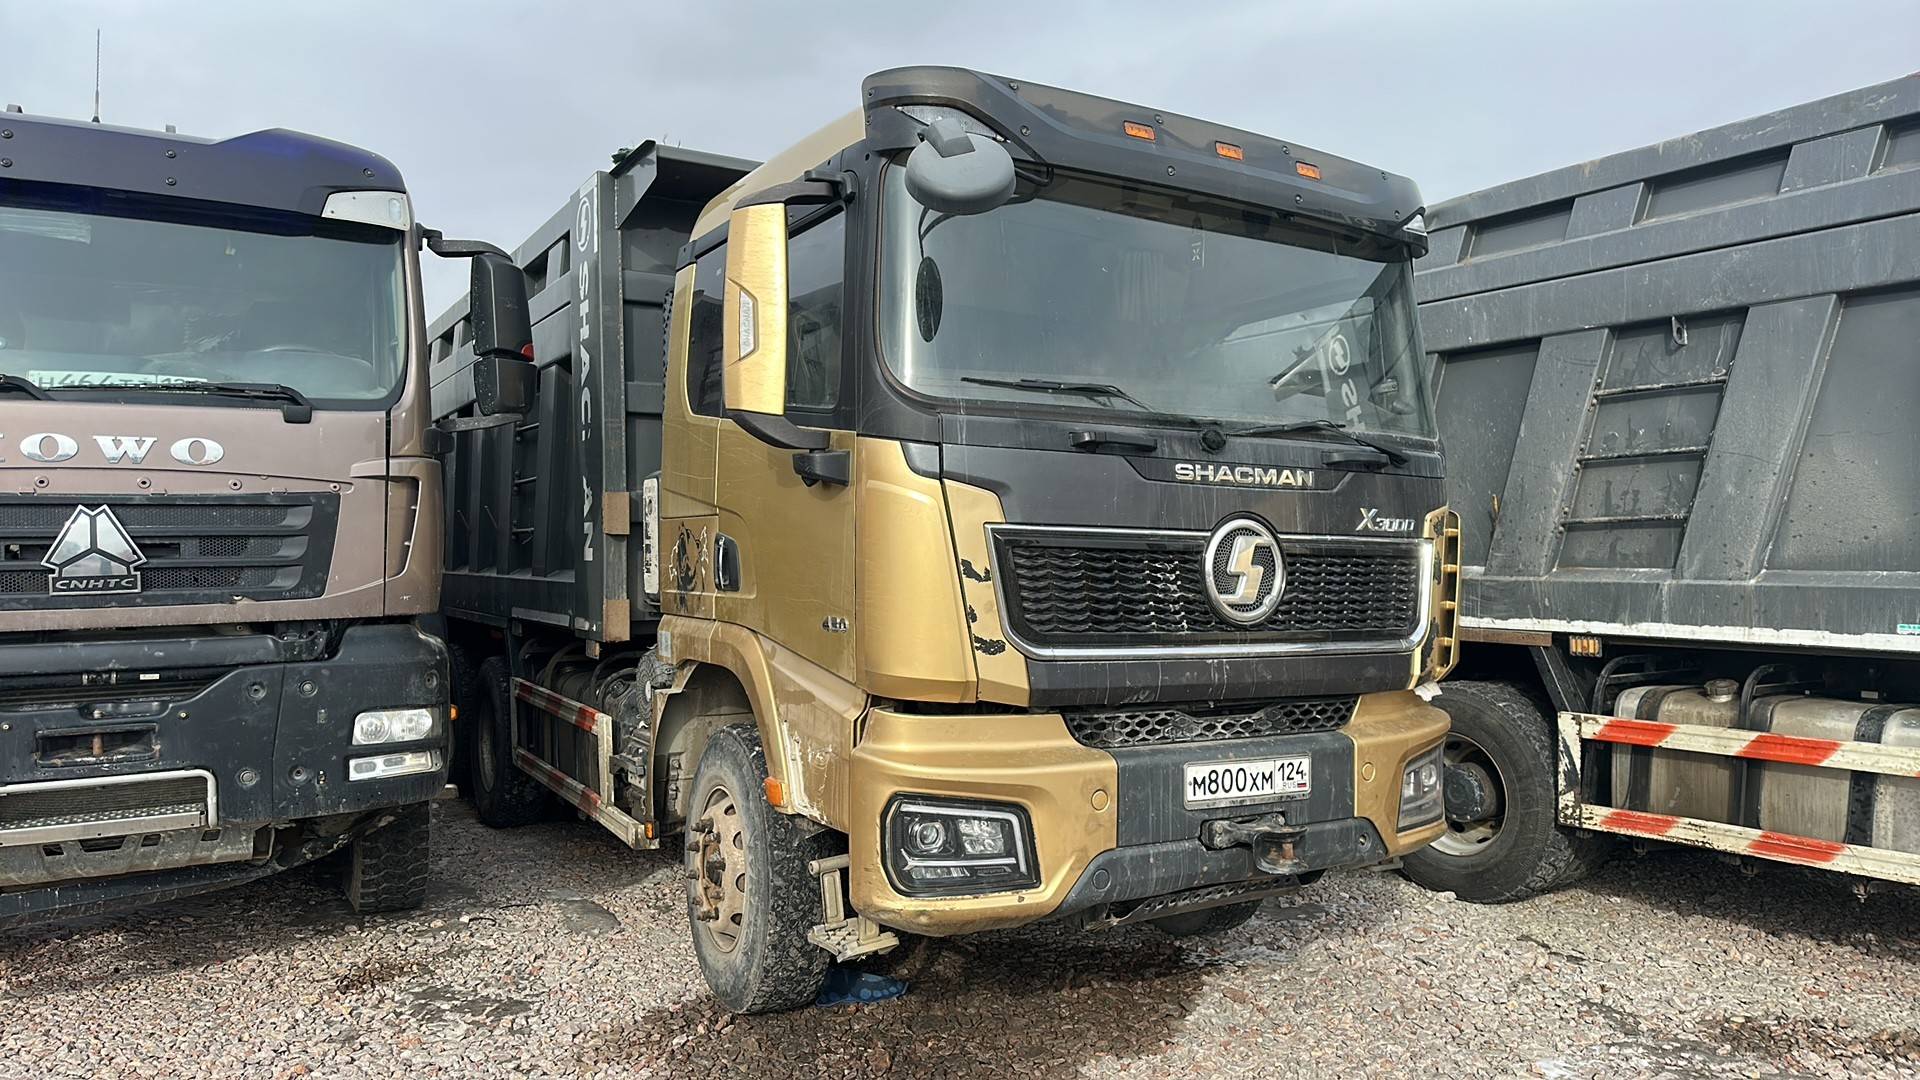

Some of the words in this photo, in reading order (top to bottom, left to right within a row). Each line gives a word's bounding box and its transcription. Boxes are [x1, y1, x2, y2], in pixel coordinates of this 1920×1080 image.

[579, 261, 594, 561] SHACAN
[0, 432, 224, 466] OWO
[1174, 463, 1315, 488] SHACMAN
[1355, 507, 1417, 533] X3000
[55, 578, 135, 590] CNHTC
[1277, 760, 1305, 782] 124
